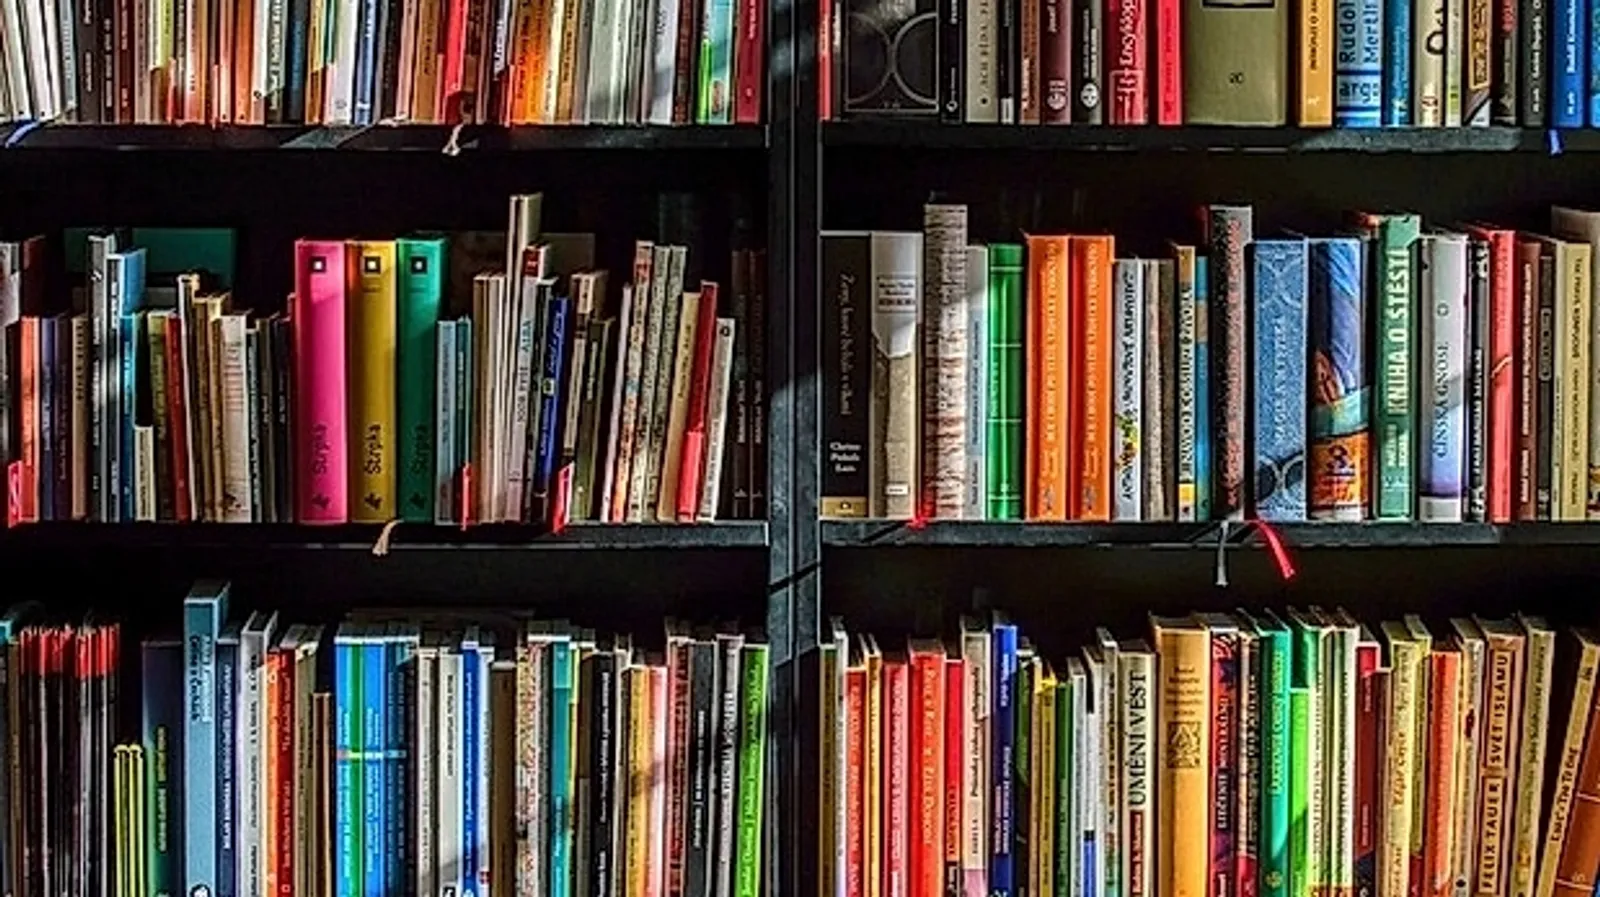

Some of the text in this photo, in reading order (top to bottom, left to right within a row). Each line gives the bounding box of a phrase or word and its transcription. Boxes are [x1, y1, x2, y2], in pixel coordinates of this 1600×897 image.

[1388, 328, 1408, 341] O
[1387, 350, 1408, 414] KNIHA
[1122, 731, 1146, 806] UMĚNÍ
[1481, 782, 1500, 889] FELIX TAUER
